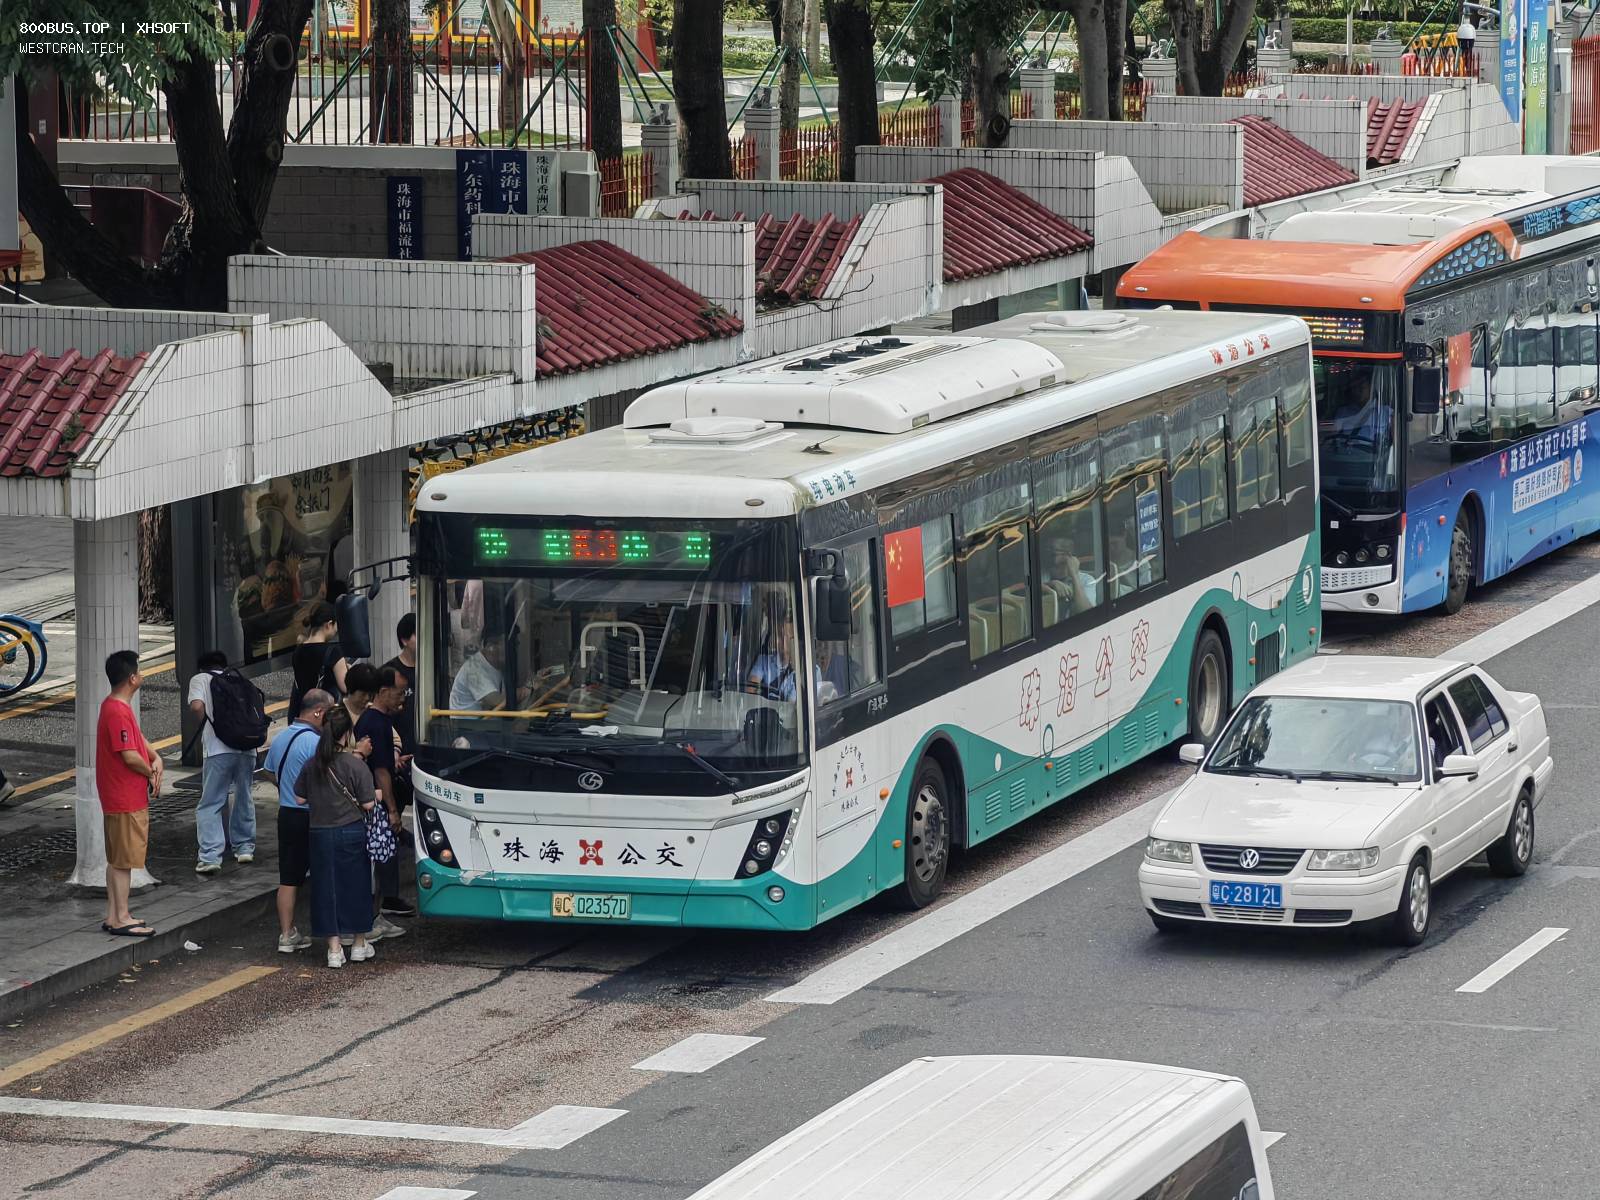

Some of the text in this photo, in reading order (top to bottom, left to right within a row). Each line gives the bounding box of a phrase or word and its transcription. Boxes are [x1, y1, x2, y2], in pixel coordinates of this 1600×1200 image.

[1510, 421, 1587, 473] 珠海公交成立45周年
[424, 780, 462, 803] 纯电动车
[502, 836, 684, 868] 珠海 公交
